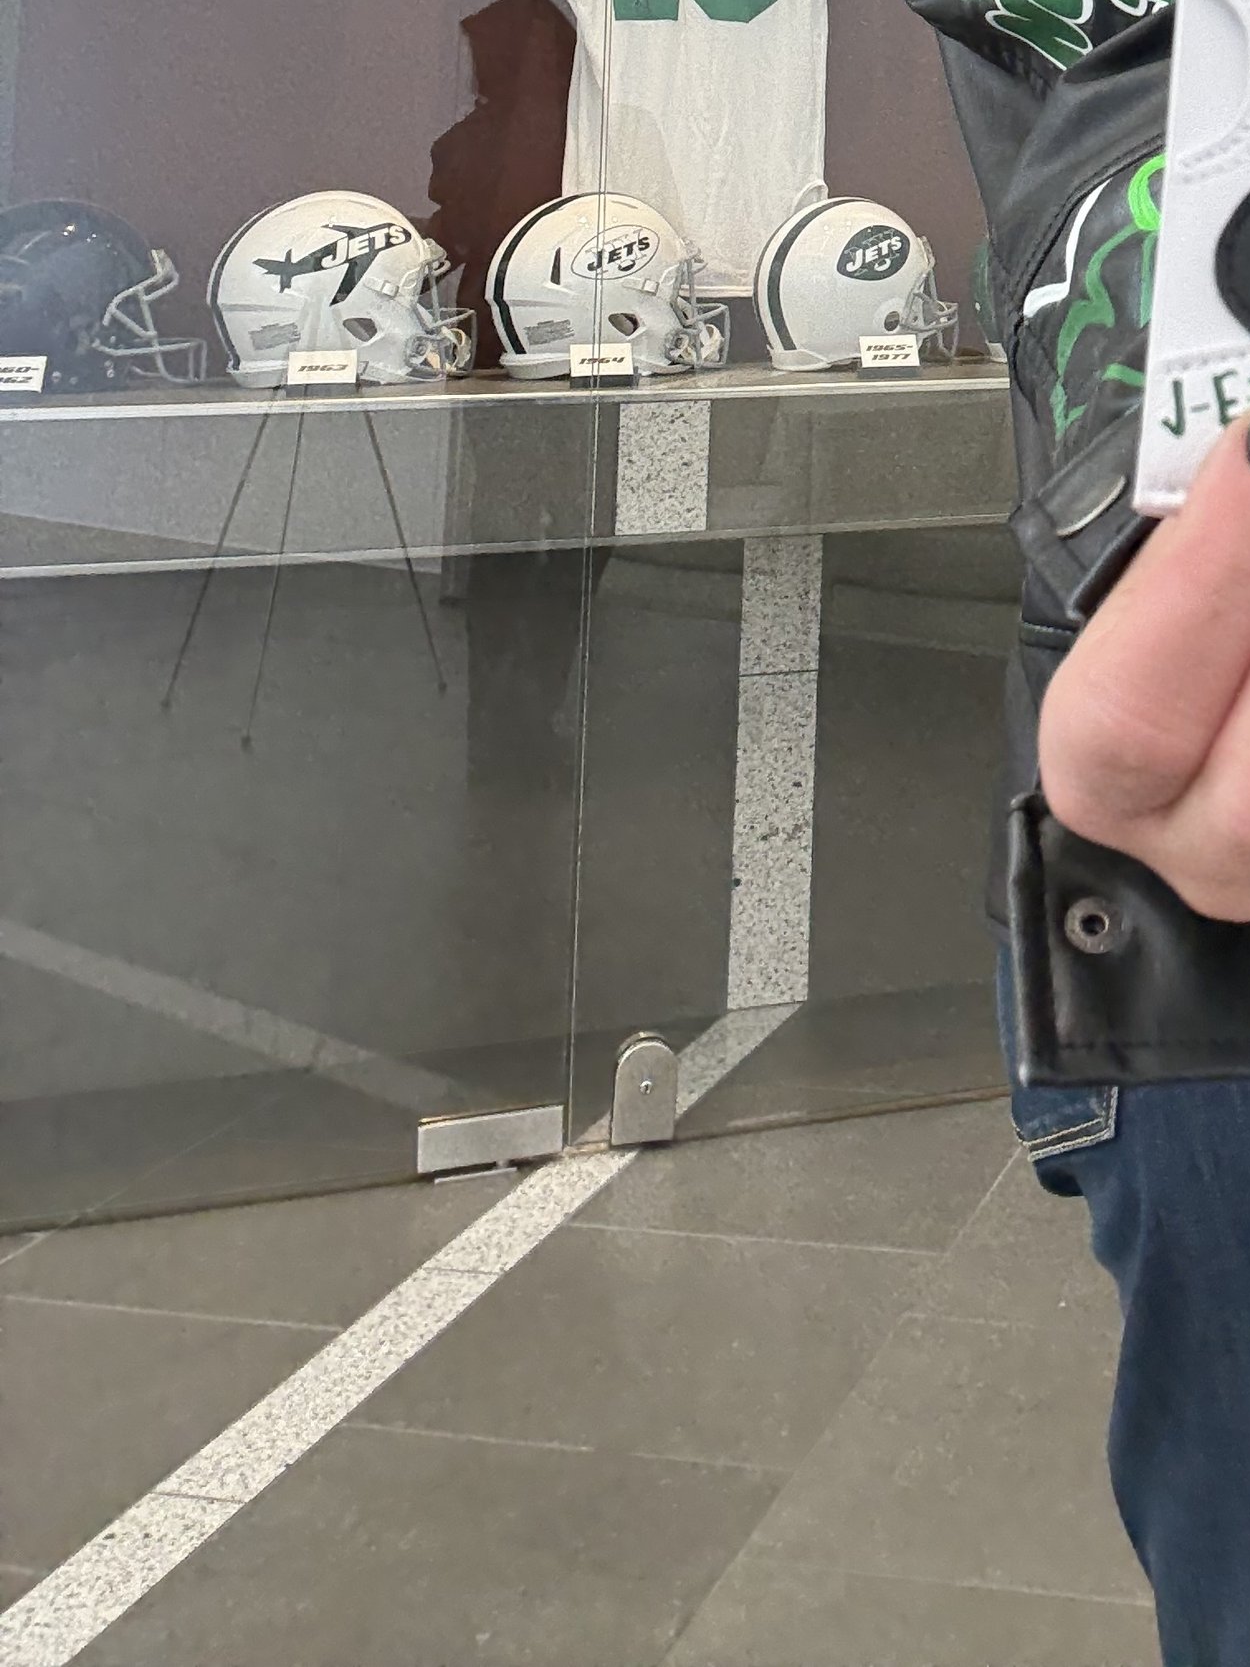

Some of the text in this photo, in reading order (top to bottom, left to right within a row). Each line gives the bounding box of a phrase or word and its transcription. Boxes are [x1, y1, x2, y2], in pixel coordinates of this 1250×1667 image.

[321, 225, 406, 269] JETS
[587, 236, 650, 272] JETS
[845, 235, 902, 272] JETS
[865, 343, 914, 352] 1965-
[578, 355, 625, 365] 1964
[871, 352, 911, 361] 1977
[297, 363, 349, 373] 1963
